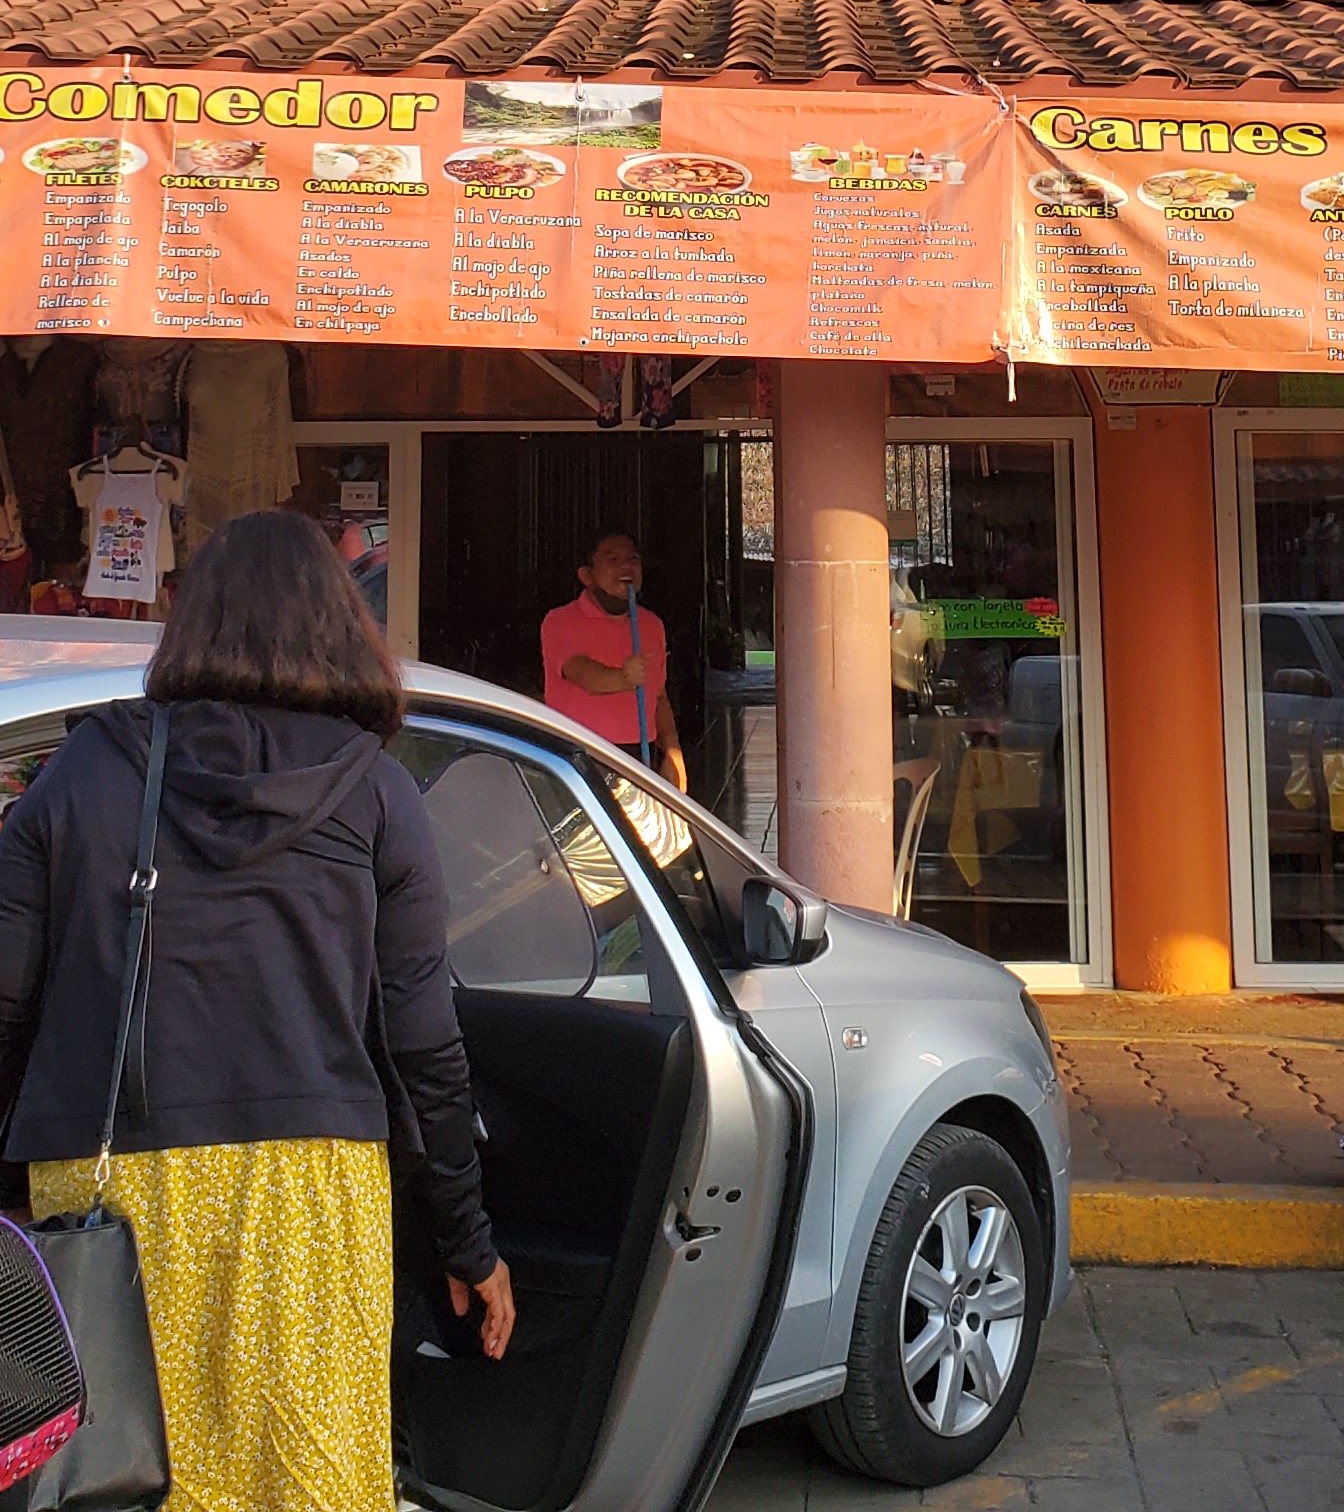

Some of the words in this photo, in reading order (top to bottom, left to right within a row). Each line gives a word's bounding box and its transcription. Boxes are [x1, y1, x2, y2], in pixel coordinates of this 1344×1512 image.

[1028, 105, 1327, 156] Carnes
[44, 171, 123, 187] FILETES
[160, 174, 279, 191] COKCTELES
[303, 179, 428, 197] CAMARONES
[829, 178, 927, 190] BEBIDAS
[465, 185, 535, 199] PULPO
[595, 189, 770, 206] RECOMENDACIÓN
[162, 197, 229, 218] Tegogolo
[623, 205, 652, 217] DE
[657, 206, 682, 218] LA
[688, 206, 741, 220] CASA
[1034, 203, 1119, 219] CARNES
[1166, 206, 1234, 222] POLLO
[454, 207, 465, 223] A
[469, 207, 484, 224] la
[488, 209, 582, 227] Veracruzana
[162, 220, 201, 235] Jaiba
[454, 232, 464, 248] A
[467, 231, 483, 248] la
[486, 232, 535, 249] diabla
[159, 242, 221, 259] Camarón
[158, 264, 197, 285] Pulpo
[452, 255, 469, 271] Al
[471, 259, 505, 280] mojo
[508, 257, 525, 273] de
[528, 261, 551, 281] ajo
[156, 287, 204, 304] Vuelve
[207, 294, 215, 304] a
[220, 289, 235, 305] la
[238, 289, 270, 305] vida
[450, 280, 547, 304] Enchipotlado
[154, 311, 243, 332] Campechana
[449, 304, 538, 323] Encebollado
